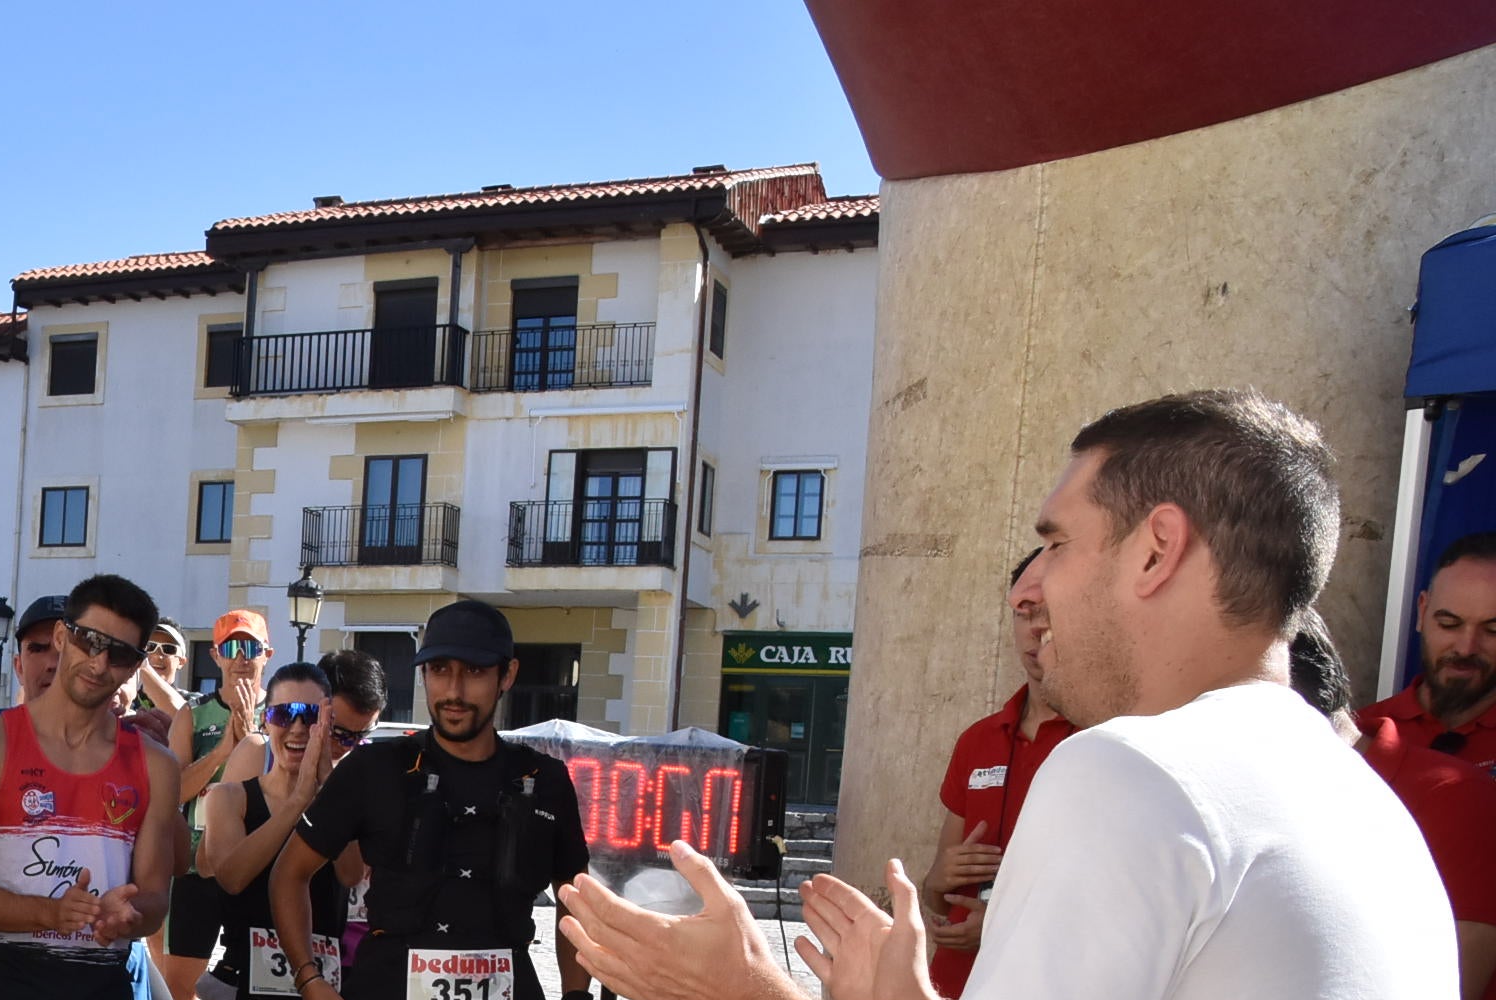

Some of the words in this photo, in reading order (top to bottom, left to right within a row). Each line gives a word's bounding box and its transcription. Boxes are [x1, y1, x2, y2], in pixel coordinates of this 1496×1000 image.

[760, 645, 817, 664] CAJA
[22, 836, 83, 883] Simón
[411, 953, 510, 974] bedunia
